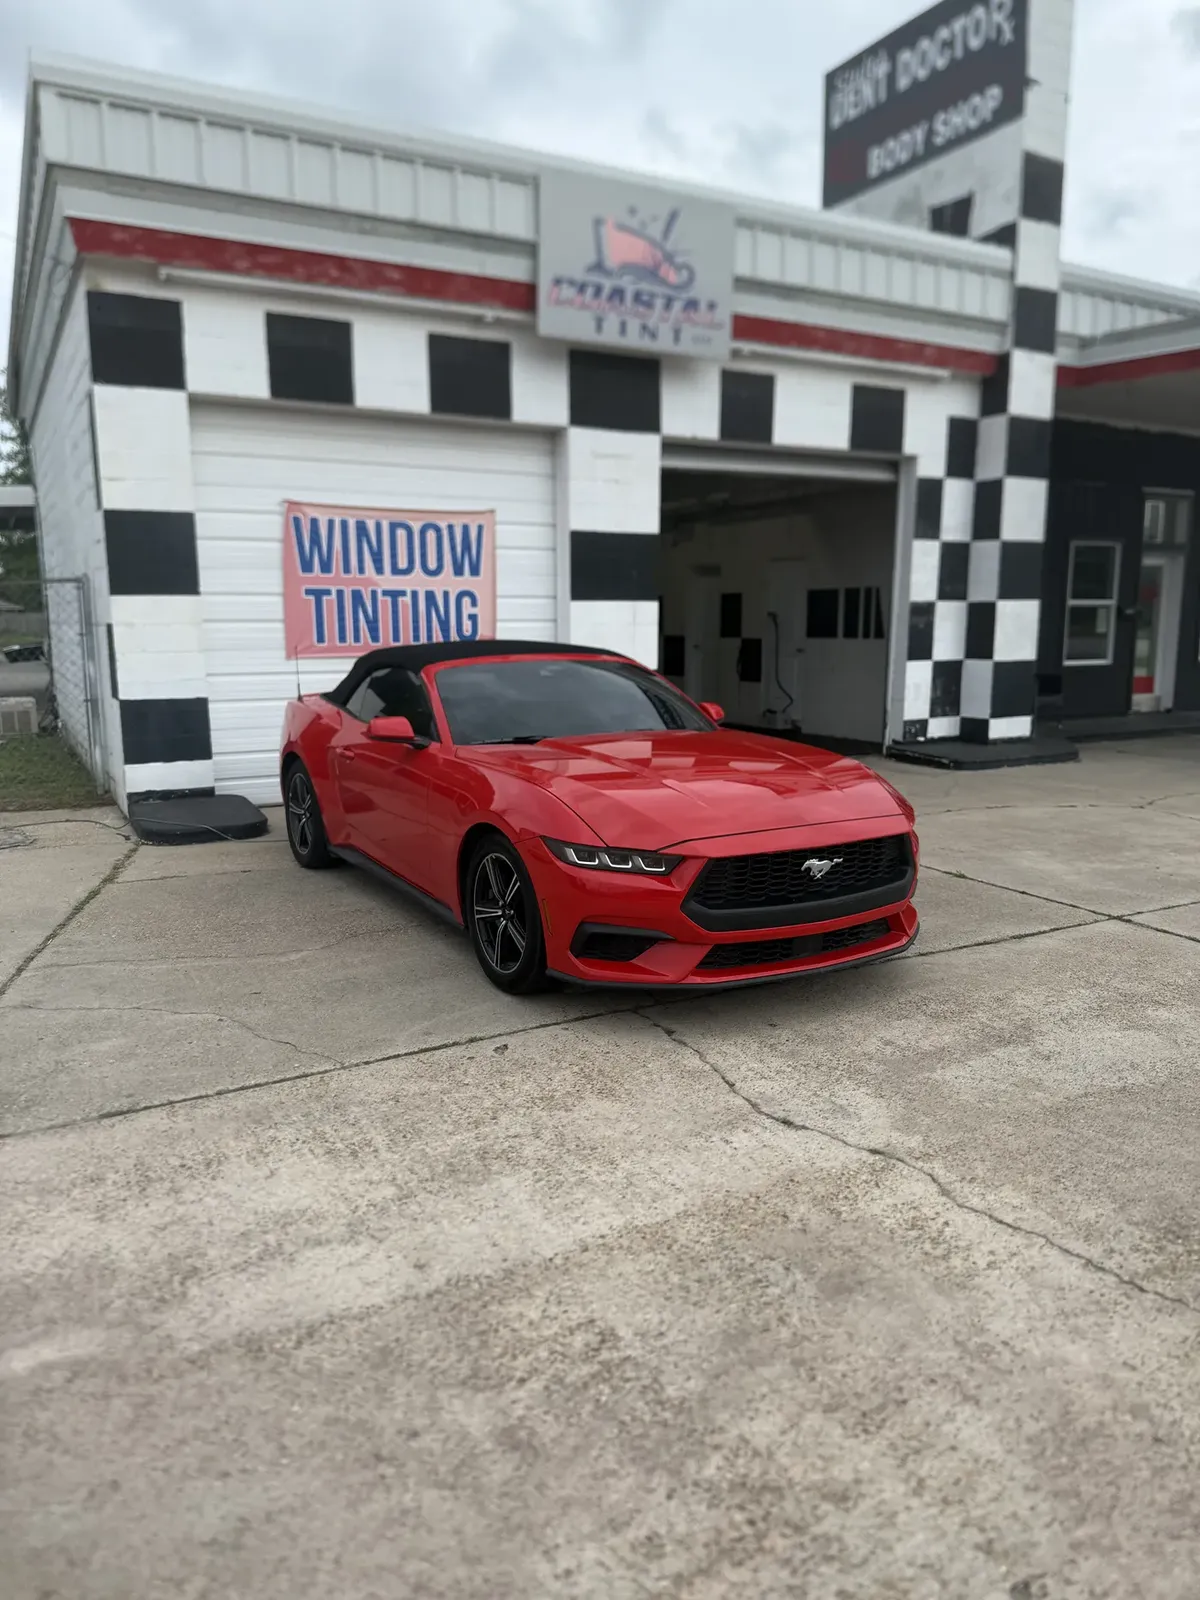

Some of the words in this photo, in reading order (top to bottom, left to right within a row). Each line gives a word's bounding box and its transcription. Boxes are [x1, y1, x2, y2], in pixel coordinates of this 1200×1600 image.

[829, 61, 891, 130] DENT
[867, 120, 929, 179] BODY
[931, 84, 1003, 146] SHOP
[549, 276, 724, 331] COASTAL
[593, 313, 684, 346] TINT
[291, 515, 485, 578] WINDOW
[304, 587, 480, 645] TINTING
